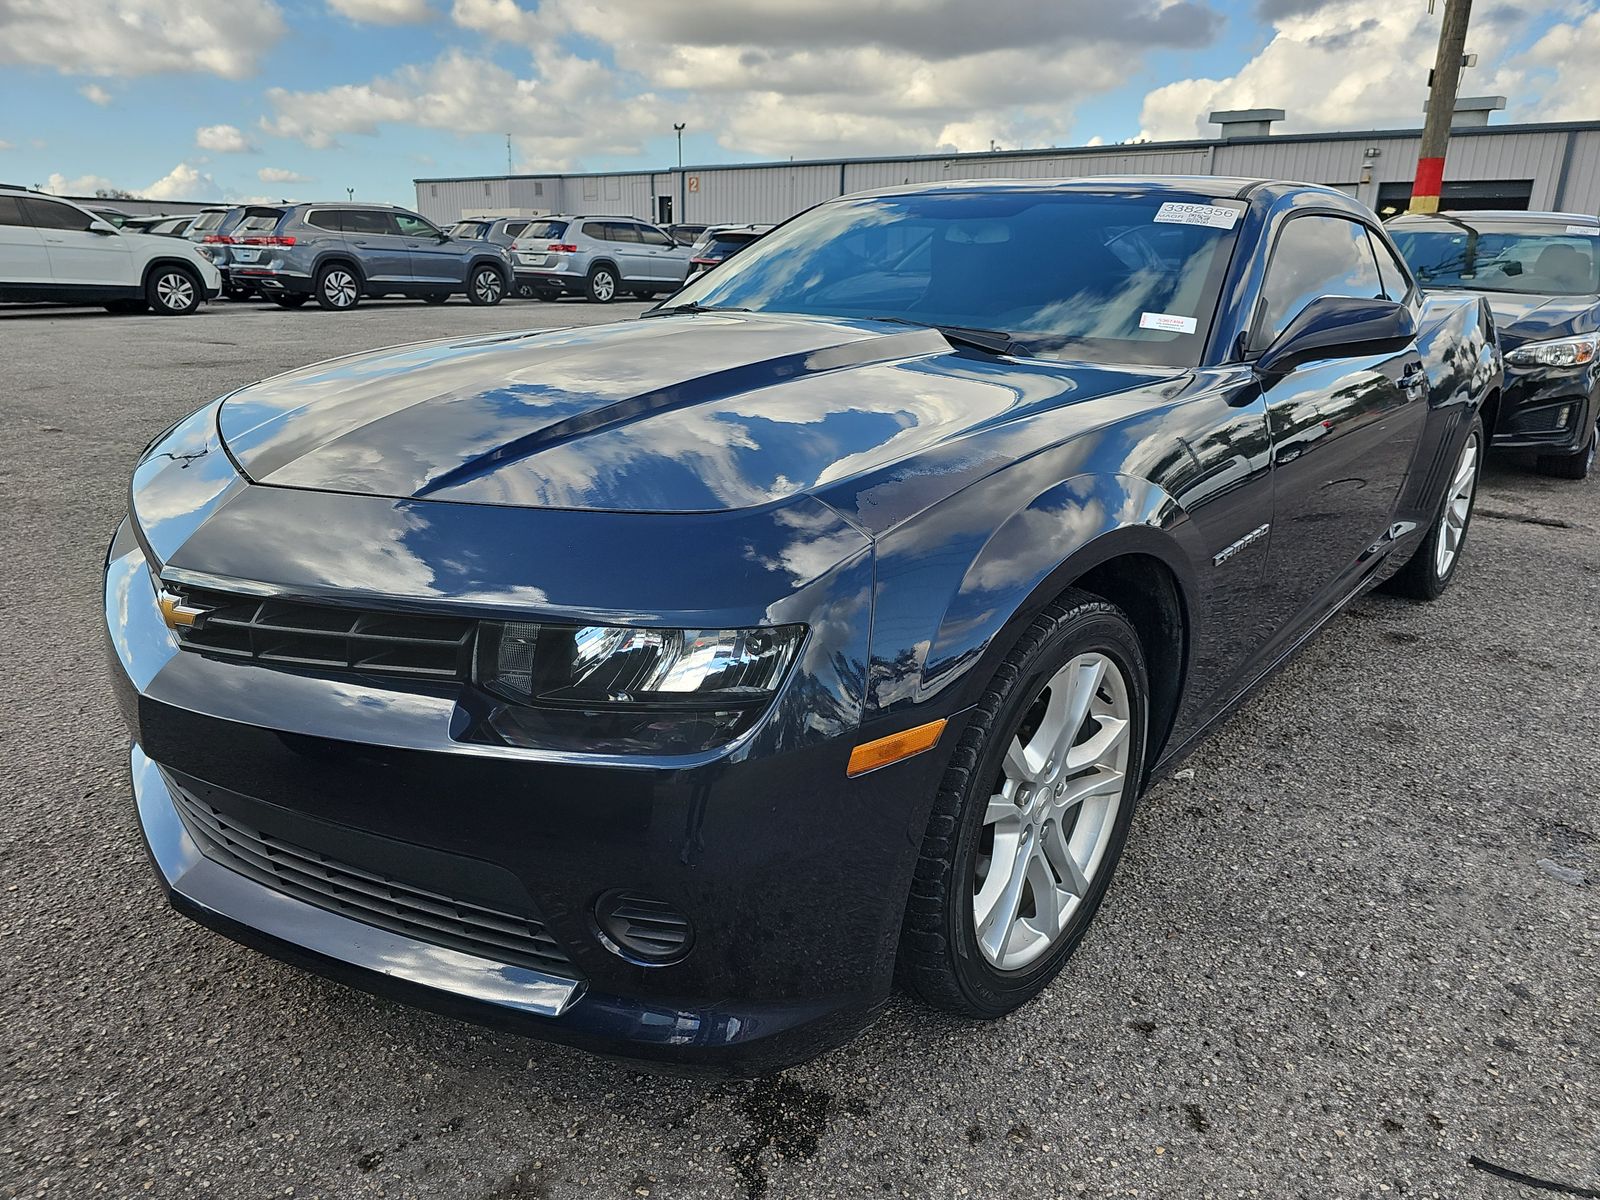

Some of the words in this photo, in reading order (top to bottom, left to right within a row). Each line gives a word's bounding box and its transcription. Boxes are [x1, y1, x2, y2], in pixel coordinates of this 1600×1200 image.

[690, 177, 698, 192] 2
[1164, 203, 1234, 218] 3382356
[1212, 523, 1270, 567] CAMARO
